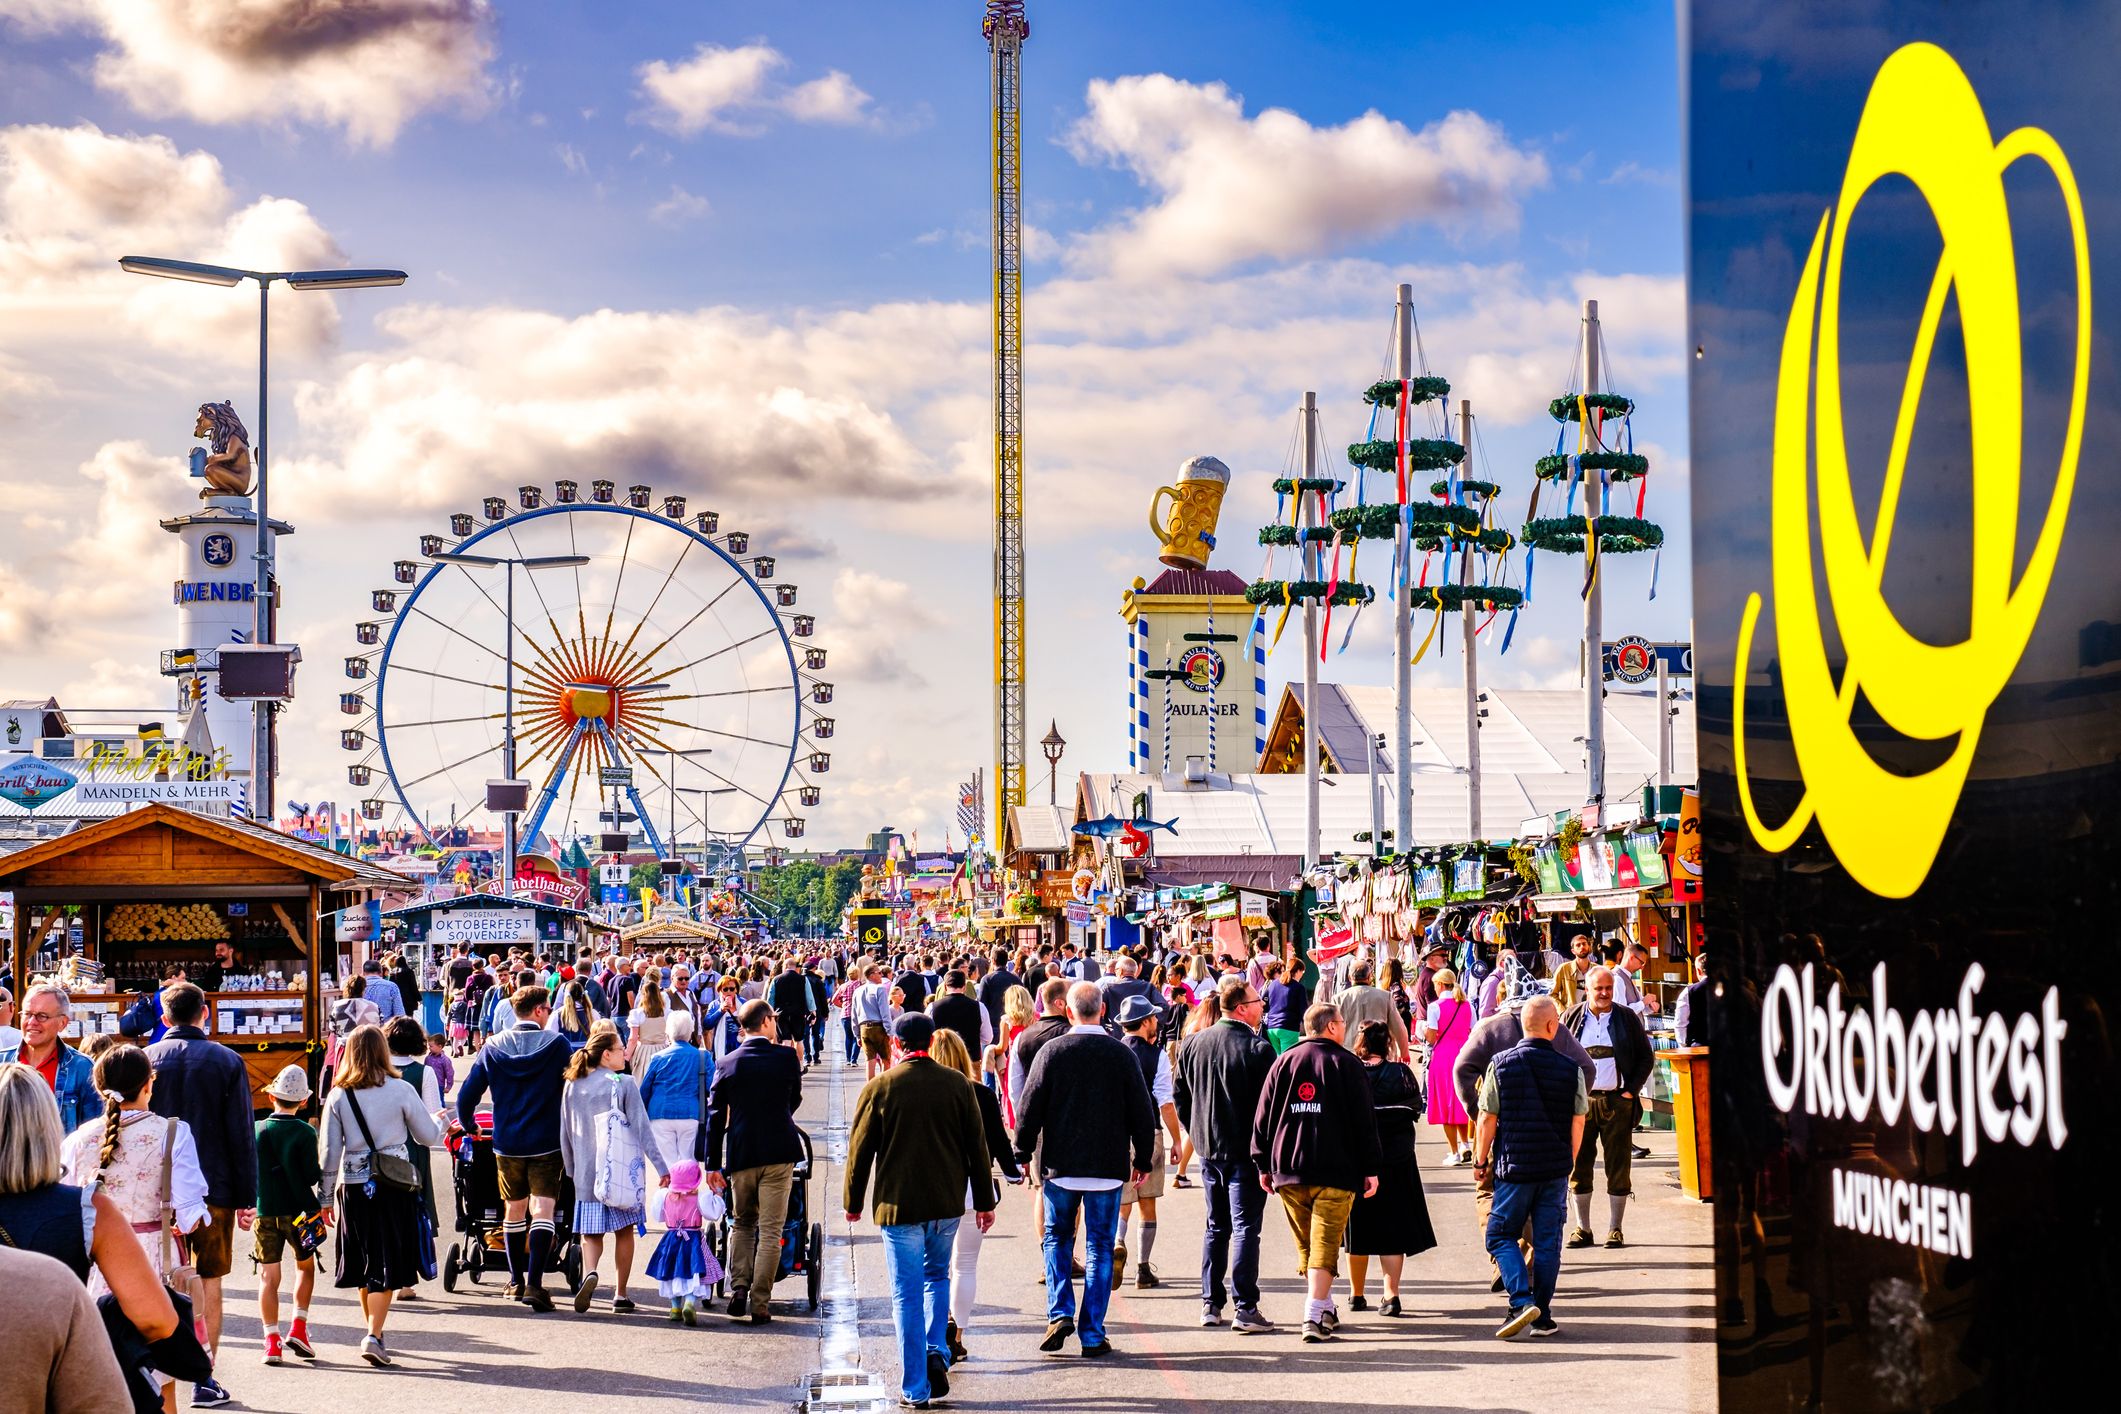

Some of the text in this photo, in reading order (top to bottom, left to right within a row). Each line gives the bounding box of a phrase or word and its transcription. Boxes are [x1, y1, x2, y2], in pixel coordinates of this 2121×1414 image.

[1613, 638, 1653, 656] PAULANER
[1181, 647, 1222, 664] PAULAER
[83, 786, 230, 799] MANDELN & MEHR
[436, 919, 531, 930] OKTOBERFEST
[448, 931, 519, 941] SOUVENIRS
[1761, 960, 2069, 1168] Oktoberfest
[1290, 1102, 1322, 1114] YAMAHA
[1832, 1167, 1973, 1260] MÜNCHEN
